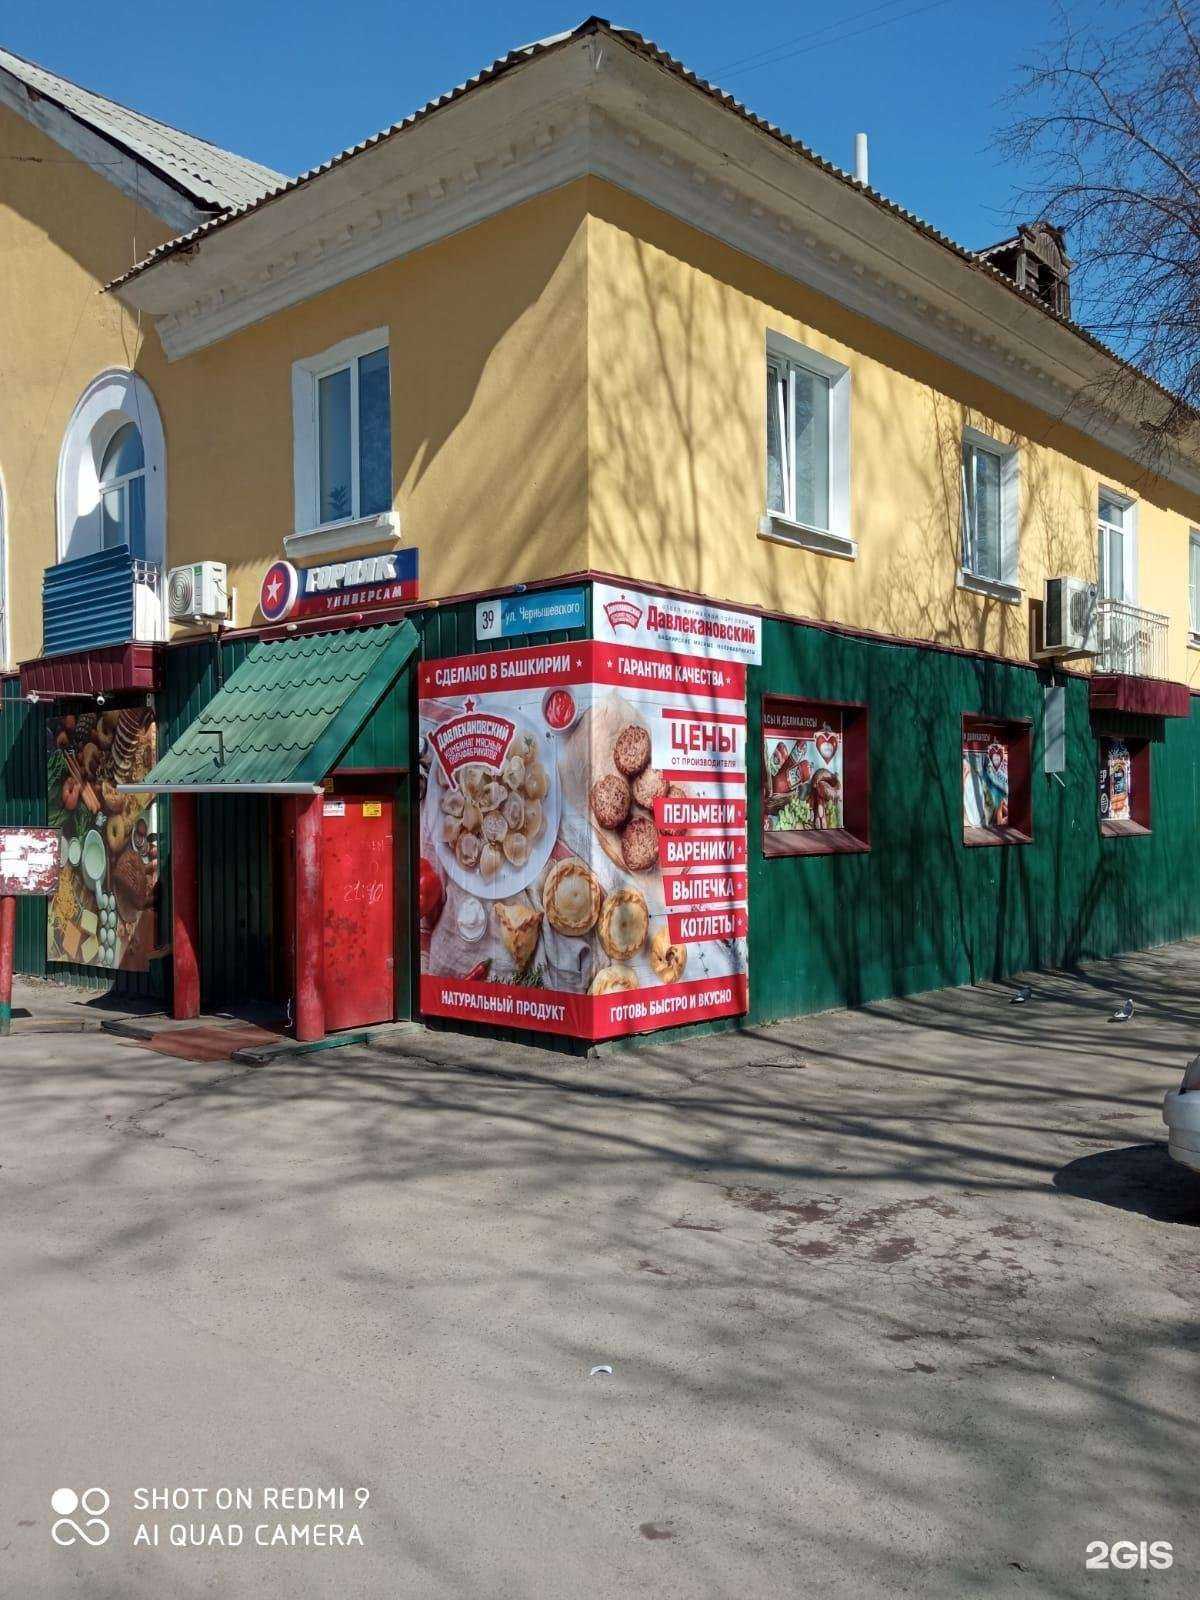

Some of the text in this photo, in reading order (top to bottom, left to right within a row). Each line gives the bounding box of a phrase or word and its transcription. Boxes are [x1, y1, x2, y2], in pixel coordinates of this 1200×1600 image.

[326, 585, 402, 609] УНИВЕРСАМ
[482, 610, 494, 630] 39
[520, 602, 580, 624] Чернышевского
[647, 605, 755, 644] Давлекановский
[435, 654, 571, 687] СДЕЛАНО В БАШКИРИИ
[618, 657, 724, 687] ГАРАНТИЯ КАЧЕСТВА
[437, 720, 509, 752] ДАВЛЕКАНОВСКИЙ
[671, 722, 736, 755] ЦЕНЫ
[671, 757, 737, 768] ОТ ПРОИЗВОДИТЕЛЯ
[663, 803, 736, 824] ПЕЛЬМЕНИ
[667, 840, 735, 862] ВАРЕНИКИ
[672, 877, 734, 901] ВЫПЕЧКА
[680, 914, 735, 938] КОТЛЕТЫ
[441, 990, 566, 1021] НАТУРАЛЬНЫЙ ПРОДУКТ
[610, 988, 732, 1023] ГОТОВЬ БЫСТРО И ВКУСНО
